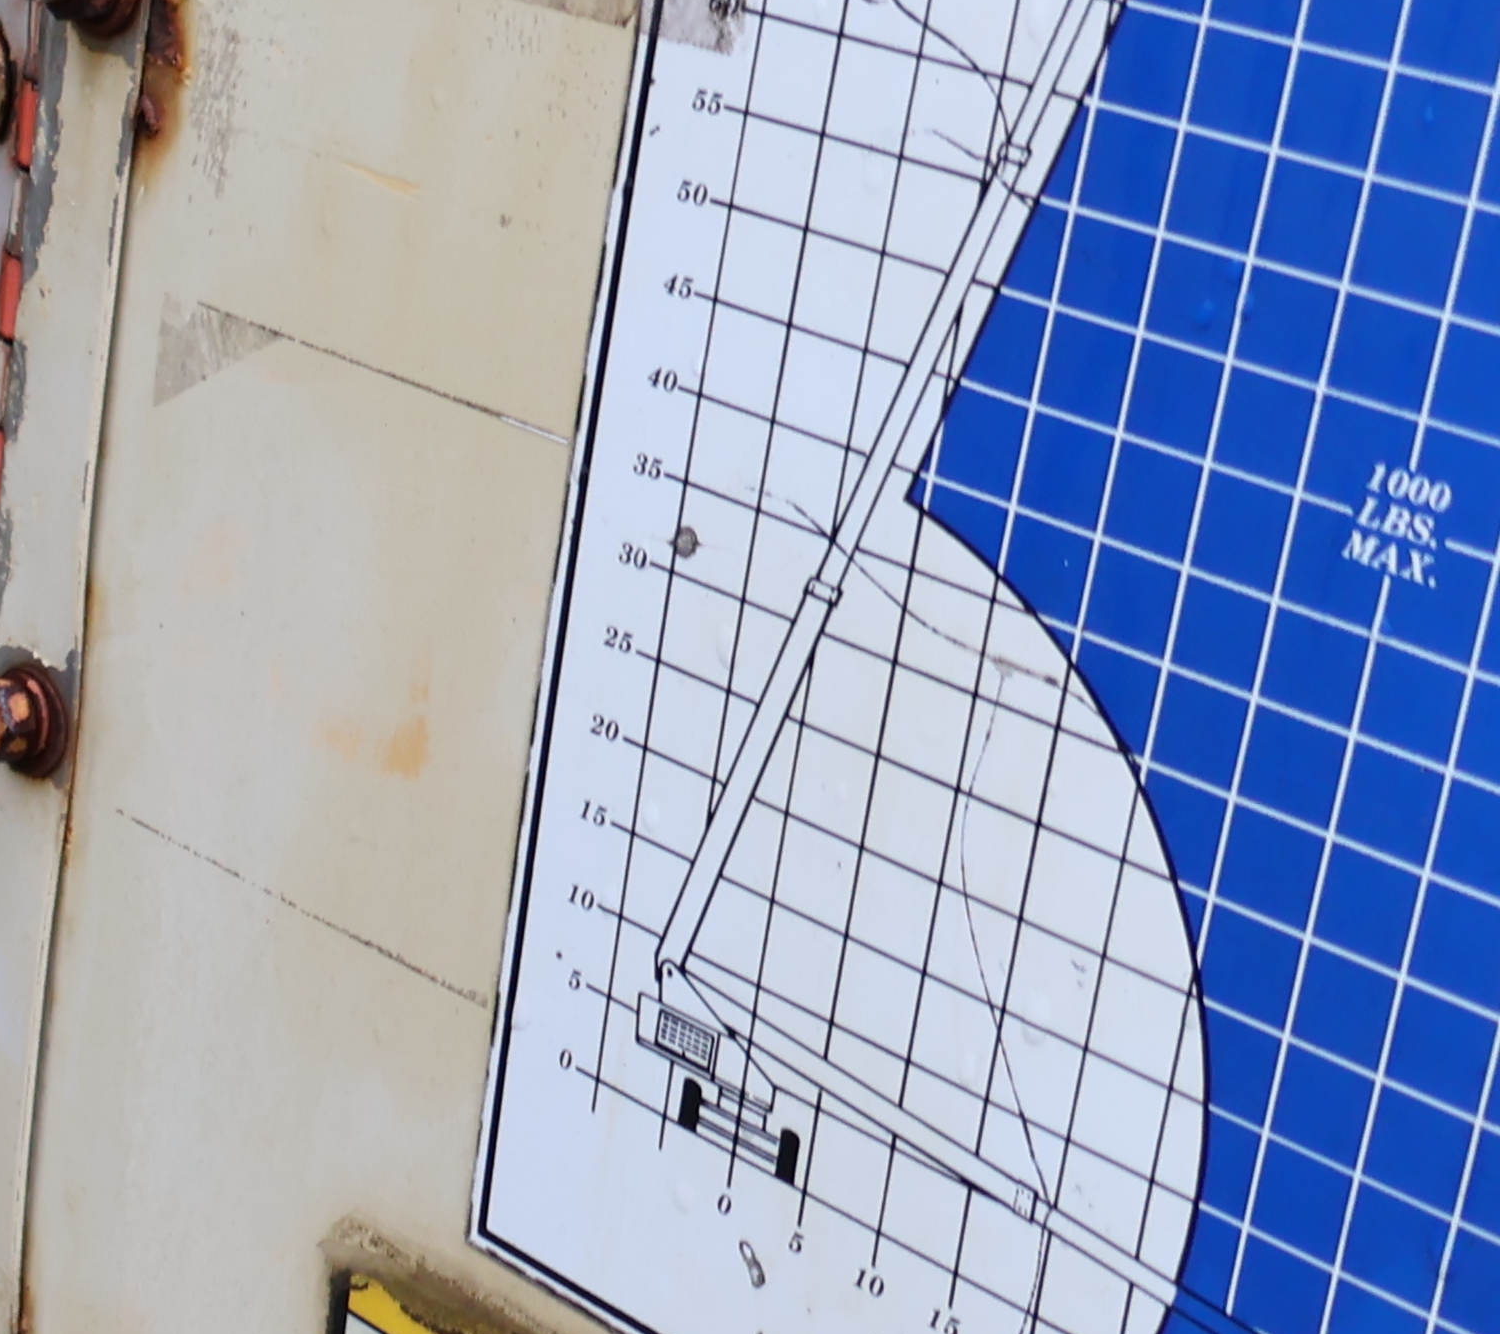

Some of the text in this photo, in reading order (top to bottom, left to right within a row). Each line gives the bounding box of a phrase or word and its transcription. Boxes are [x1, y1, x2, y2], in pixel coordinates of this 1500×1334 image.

[692, 90, 724, 117] 55
[677, 182, 709, 207] 50
[663, 275, 694, 300] 45
[1364, 464, 1454, 512] 1000
[1355, 498, 1438, 549] LBS.
[1342, 532, 1439, 590] MAX.
